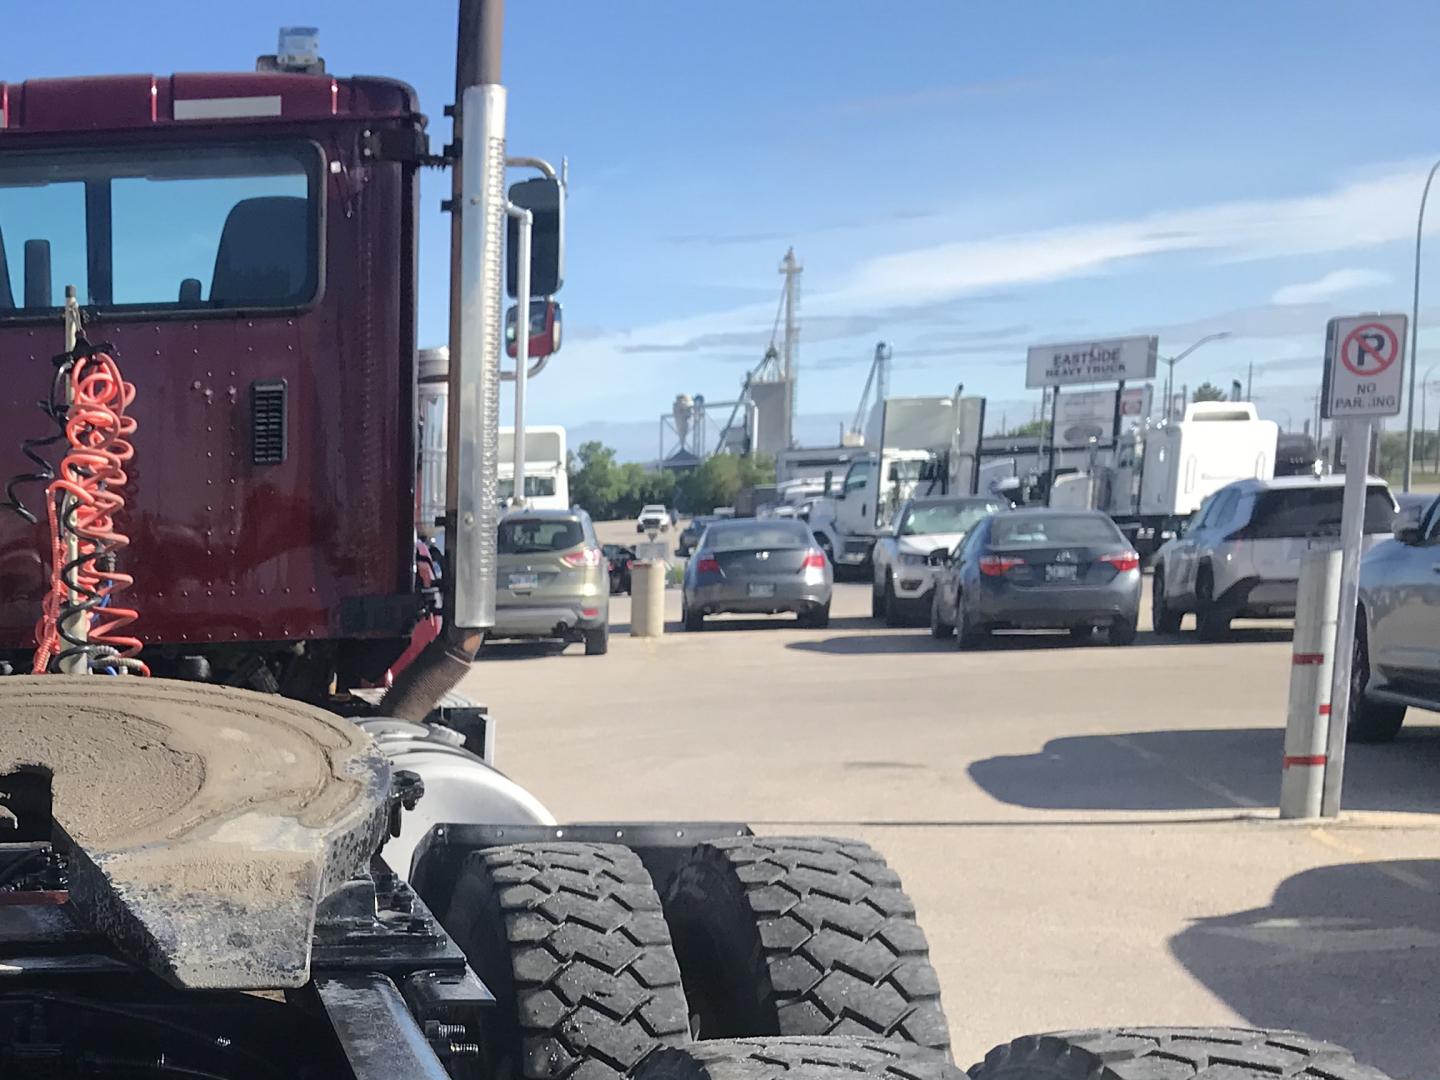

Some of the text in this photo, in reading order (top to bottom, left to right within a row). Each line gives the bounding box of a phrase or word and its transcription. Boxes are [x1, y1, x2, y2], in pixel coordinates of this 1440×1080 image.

[1053, 347, 1120, 367] EASTSIDE
[1357, 333, 1385, 366] P
[1045, 363, 1126, 377] HEAVY TRUCK
[1357, 383, 1376, 395] NO
